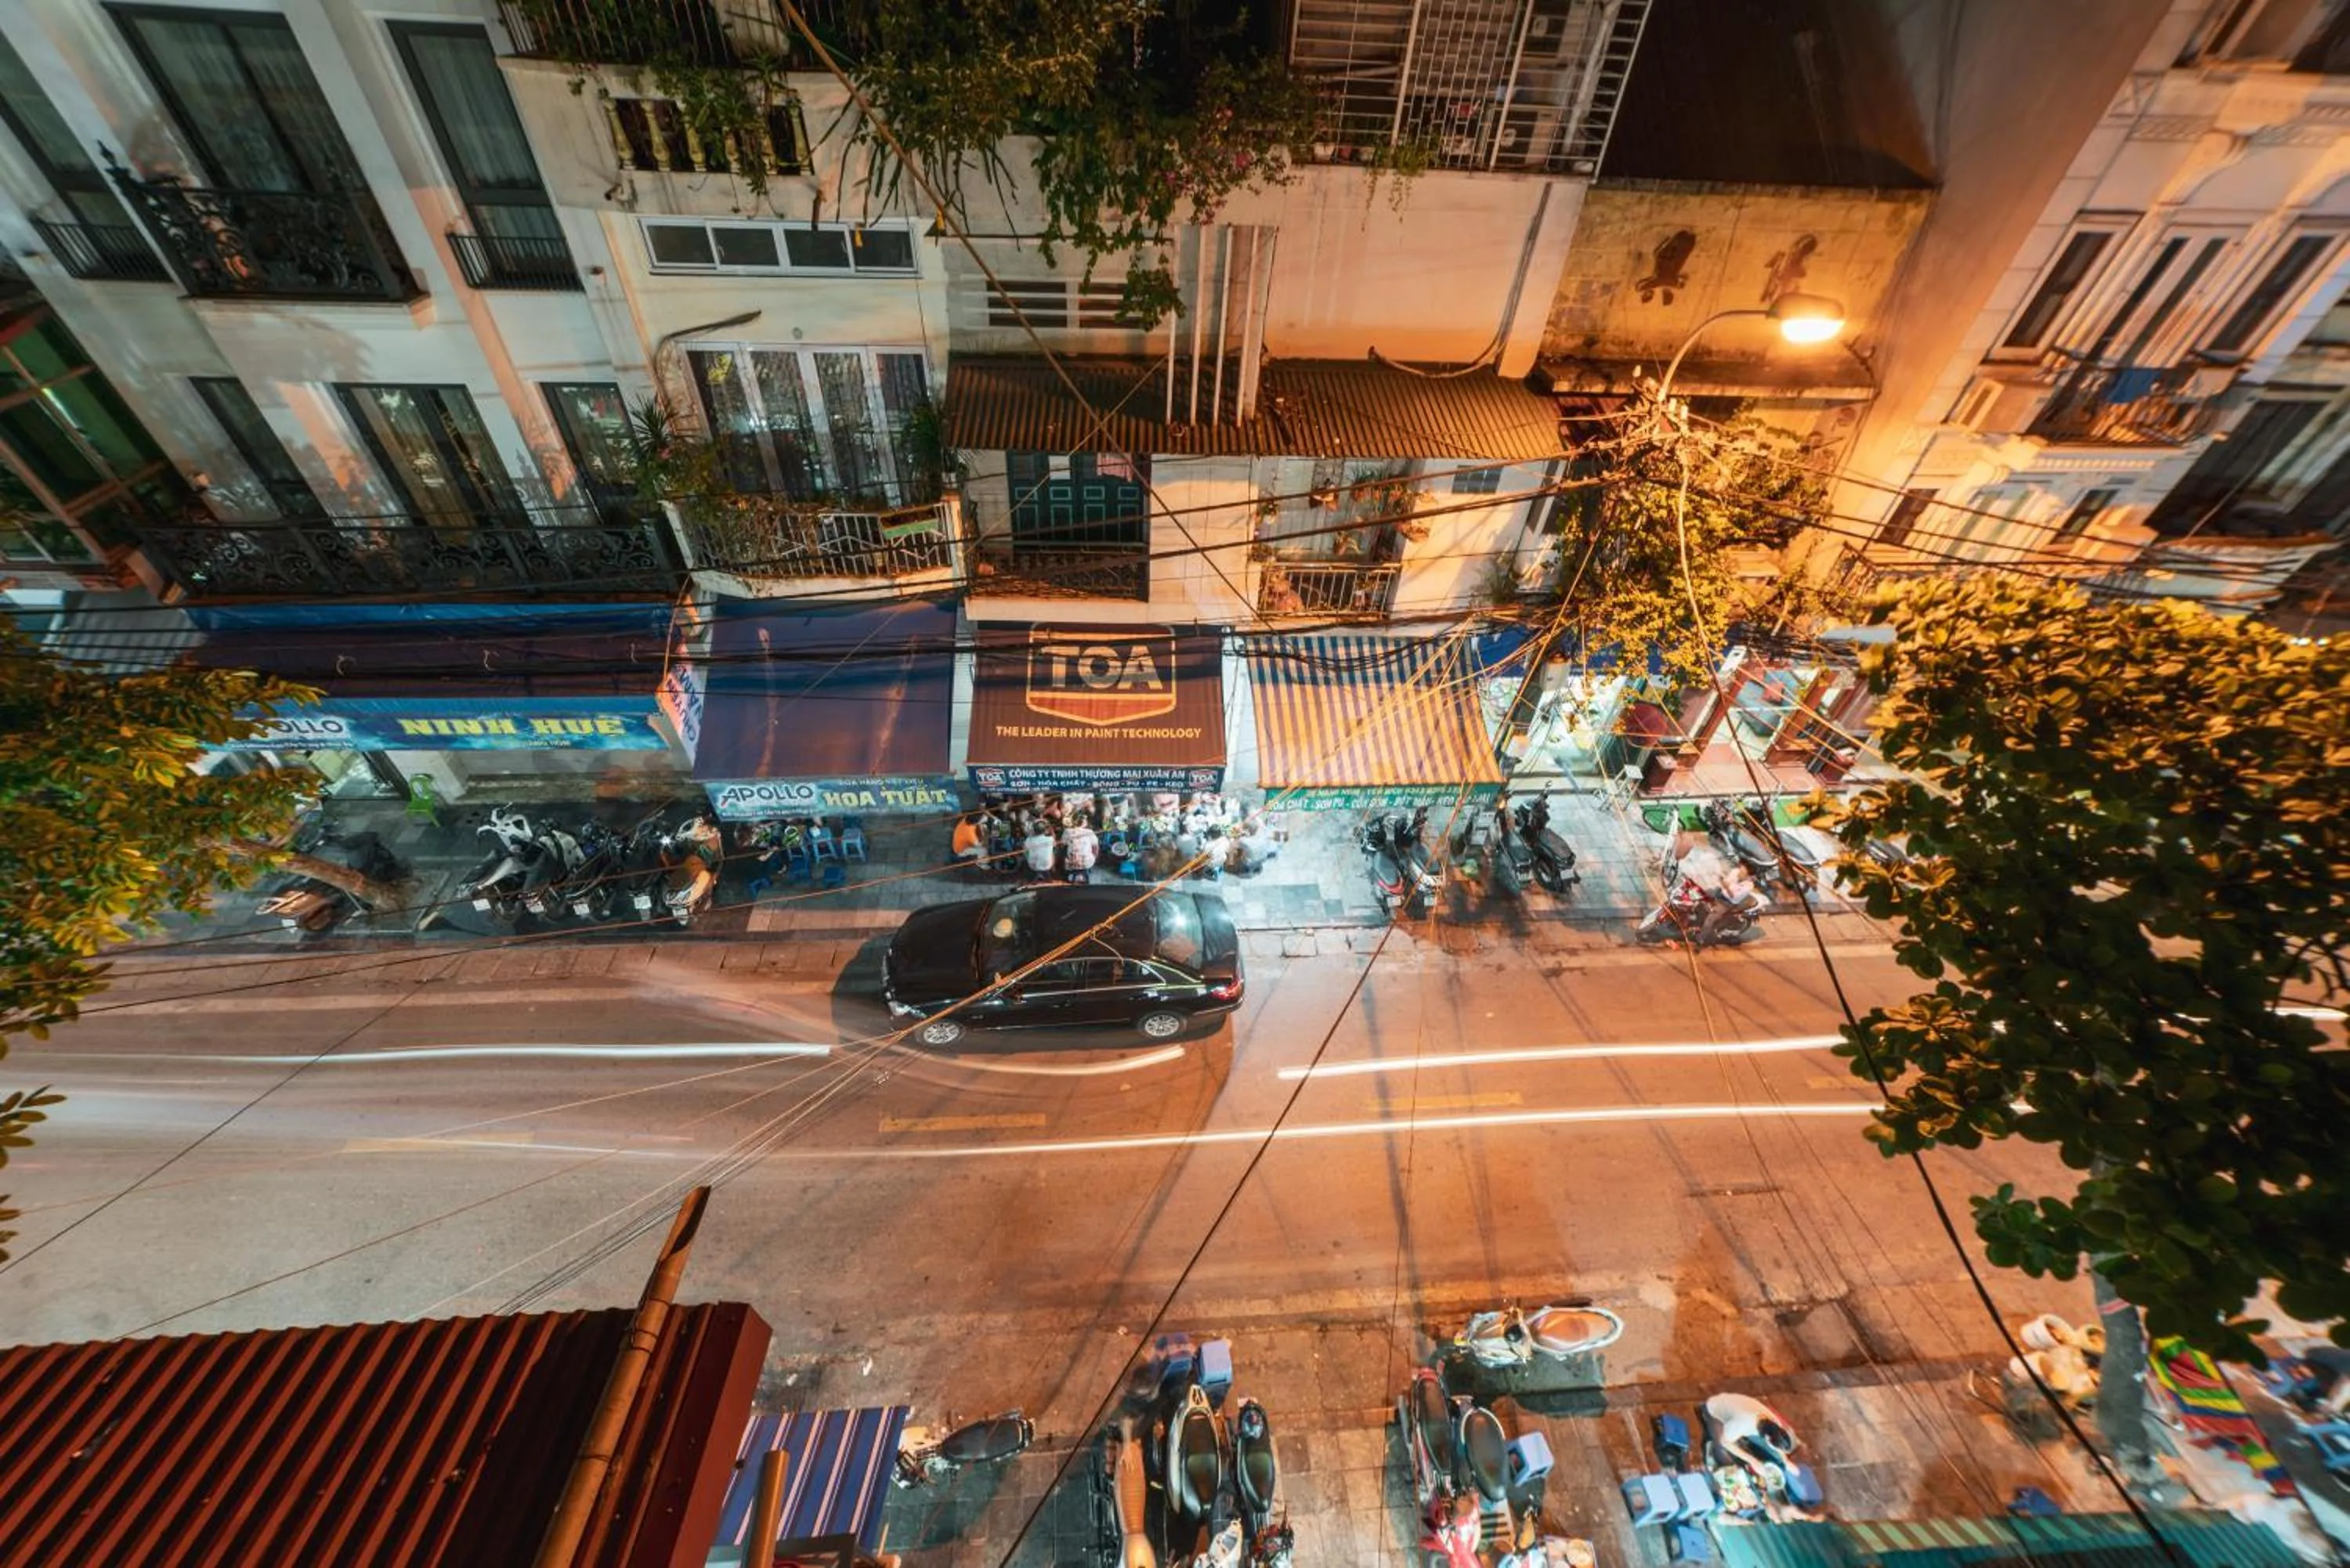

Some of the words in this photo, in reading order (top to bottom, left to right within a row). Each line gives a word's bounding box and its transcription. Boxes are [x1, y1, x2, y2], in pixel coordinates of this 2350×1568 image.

[1040, 645, 1162, 689] TOA
[398, 718, 517, 735] NINH
[996, 726, 1019, 737] THE
[1021, 726, 1067, 738] LEADER
[1069, 727, 1083, 738] IN
[1085, 728, 1119, 739] PAINT
[1121, 728, 1201, 739] TECHNOLOGY
[1009, 768, 1036, 778] CÔNG
[1037, 770, 1050, 779] TY
[1051, 769, 1079, 779] TNHH
[1171, 769, 1185, 779] AN
[1193, 774, 1213, 782] TOA
[721, 785, 813, 806] APOLLO
